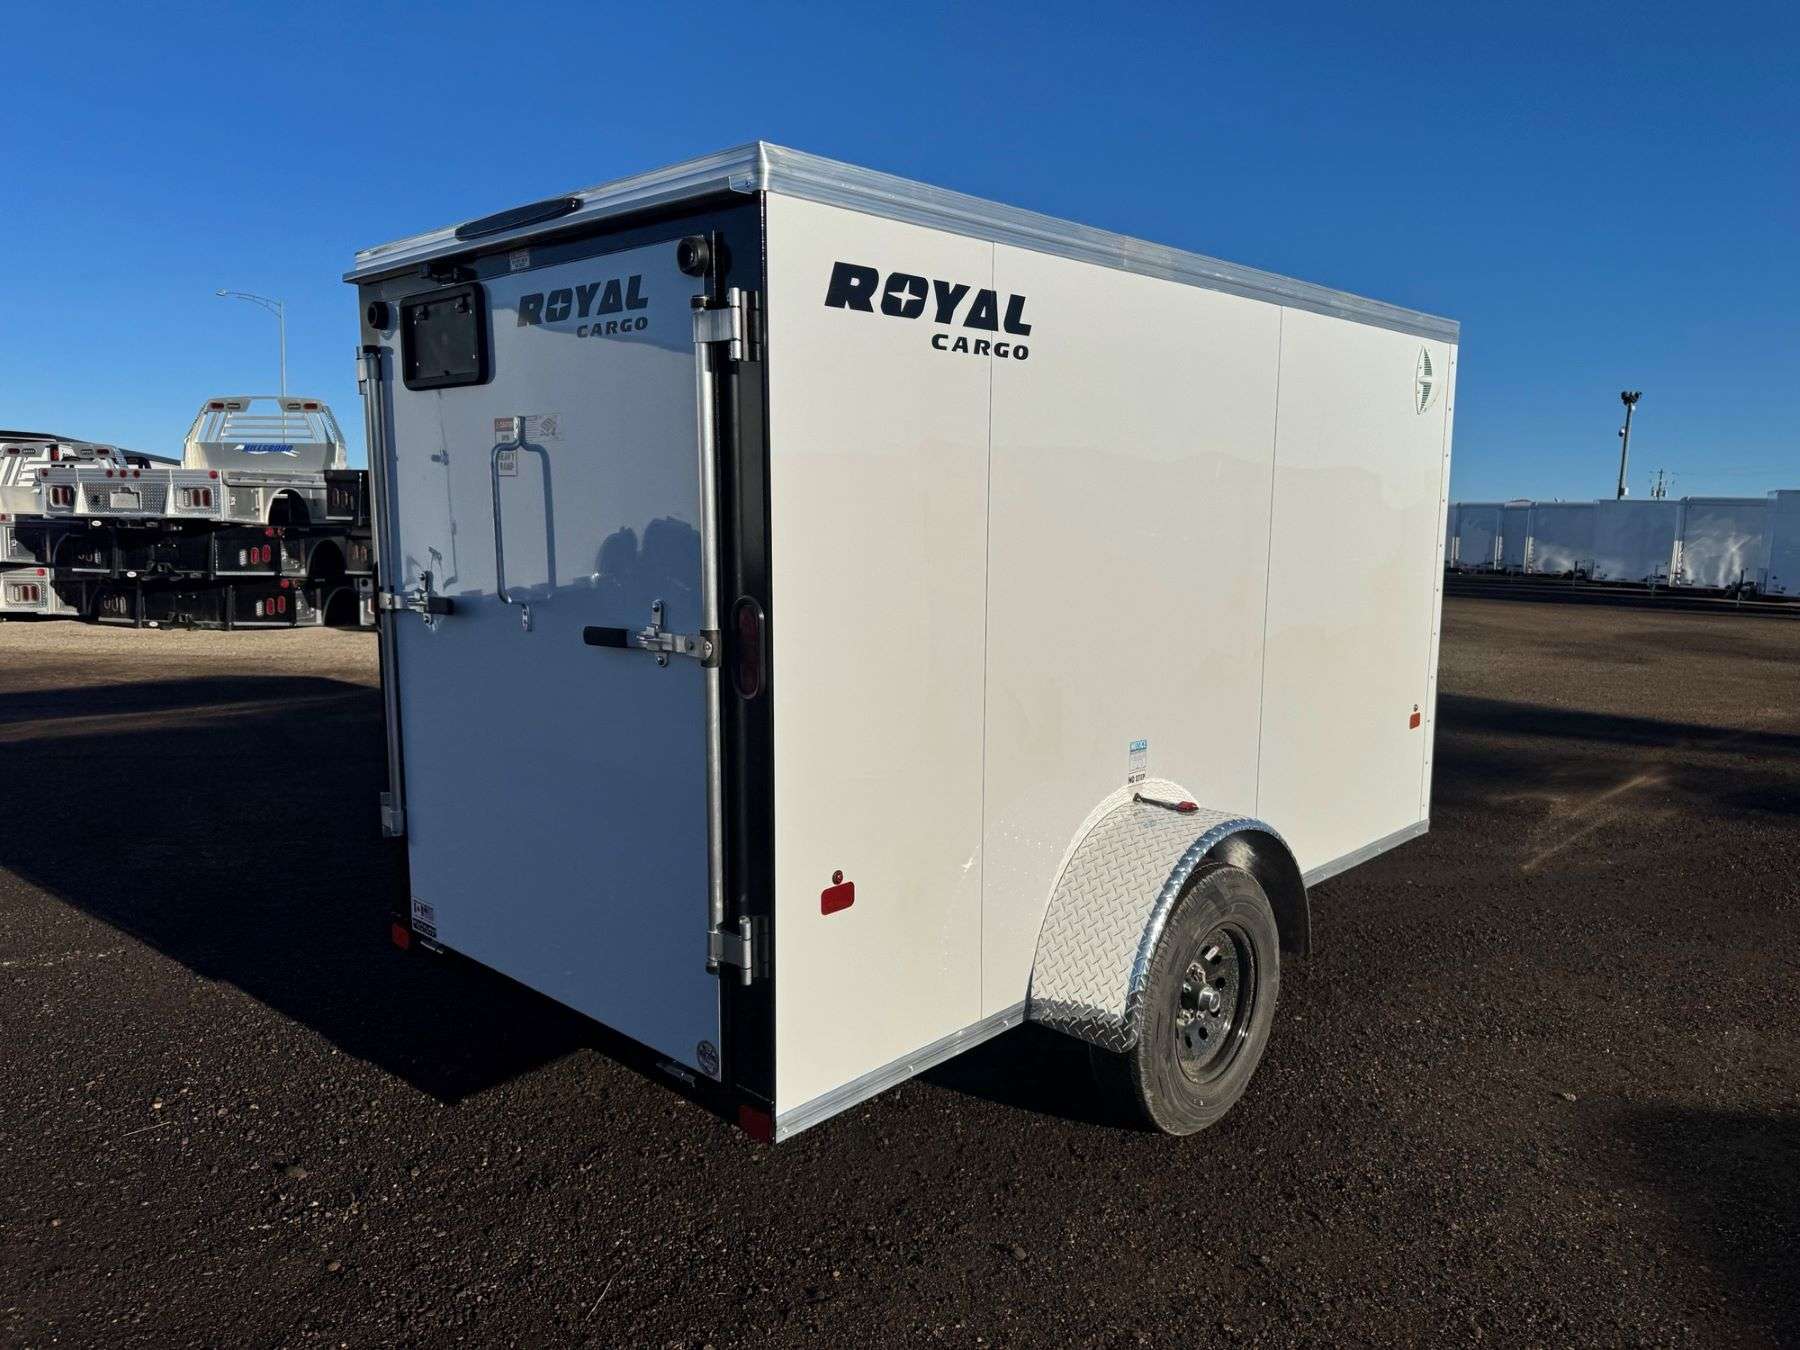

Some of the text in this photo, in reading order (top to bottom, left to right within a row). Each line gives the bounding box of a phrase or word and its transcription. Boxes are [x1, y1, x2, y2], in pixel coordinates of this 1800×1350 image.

[517, 274, 649, 326] ROYAL
[824, 261, 1032, 336] ROYAL
[577, 316, 648, 338] CARGO
[931, 333, 1029, 360] CARGO
